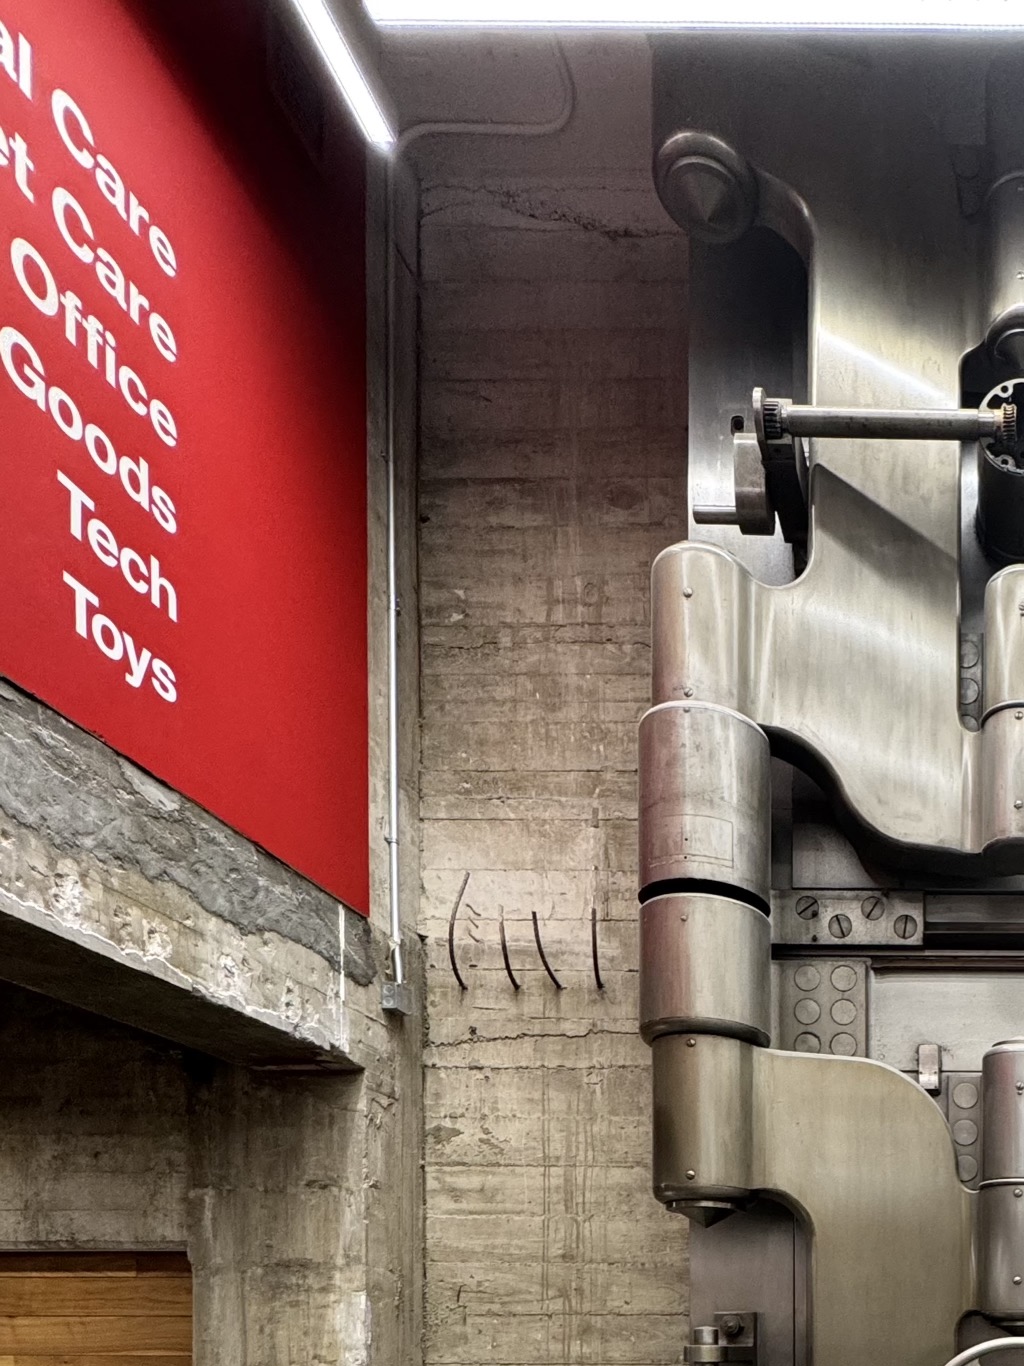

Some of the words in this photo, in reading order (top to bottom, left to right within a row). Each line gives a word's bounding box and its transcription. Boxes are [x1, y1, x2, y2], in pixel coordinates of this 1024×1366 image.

[51, 88, 178, 278] Care
[51, 186, 178, 363] Care
[0, 326, 178, 534] Goods
[10, 237, 178, 448] Office
[57, 469, 178, 623] Tech
[63, 570, 178, 703] Toys
